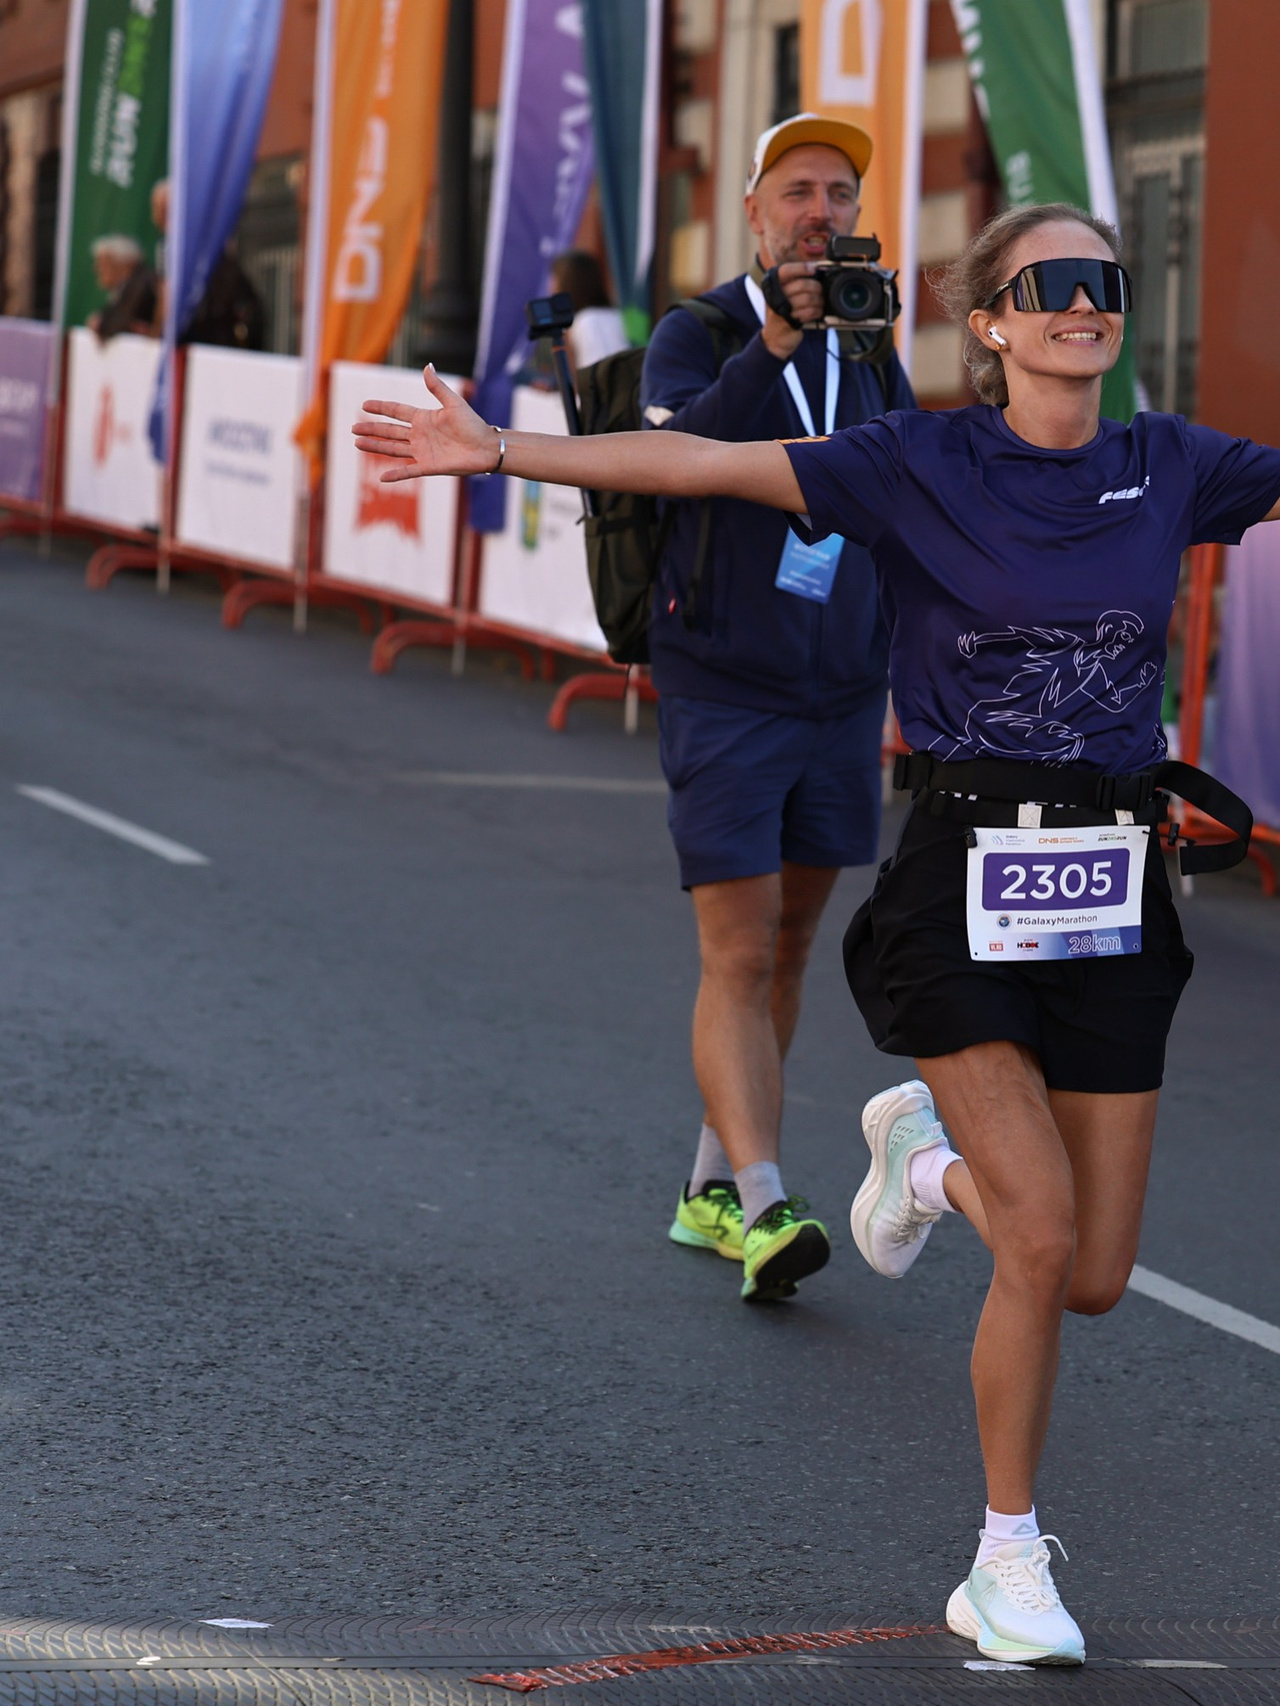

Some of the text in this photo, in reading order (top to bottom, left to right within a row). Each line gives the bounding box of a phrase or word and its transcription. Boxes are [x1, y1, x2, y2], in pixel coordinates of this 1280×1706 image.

[1000, 861, 1112, 900] 2305
[1016, 914, 1098, 926] #GalaxyMarathon
[1068, 934, 1121, 953] 28km
